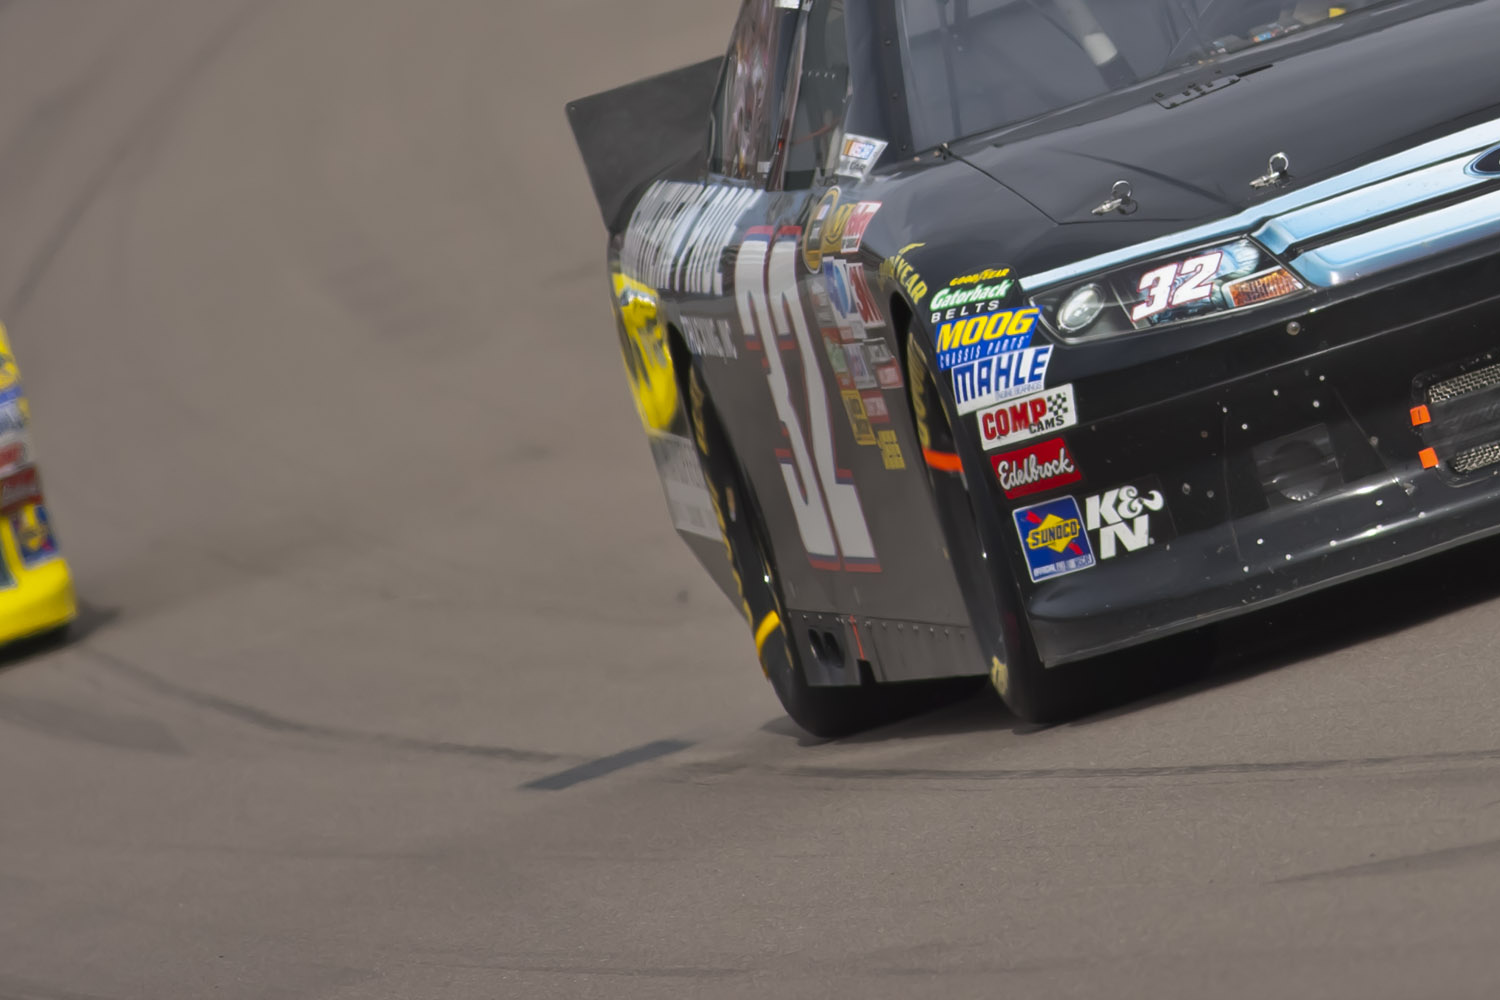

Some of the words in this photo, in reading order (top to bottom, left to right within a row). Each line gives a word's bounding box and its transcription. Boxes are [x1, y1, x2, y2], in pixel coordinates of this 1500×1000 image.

[930, 279, 1014, 311] Gatorback
[1131, 250, 1223, 322] 32
[931, 300, 1000, 323] BELTS
[936, 307, 1040, 353] MOOG
[940, 345, 981, 369] CHASSIS
[986, 336, 1026, 355] PARTS
[955, 349, 1050, 404] MAHLE
[982, 397, 1047, 440] COMP
[1028, 415, 1065, 434] CAMS
[998, 448, 1075, 490] Edelbrock
[1030, 521, 1078, 547] SUNOCO
